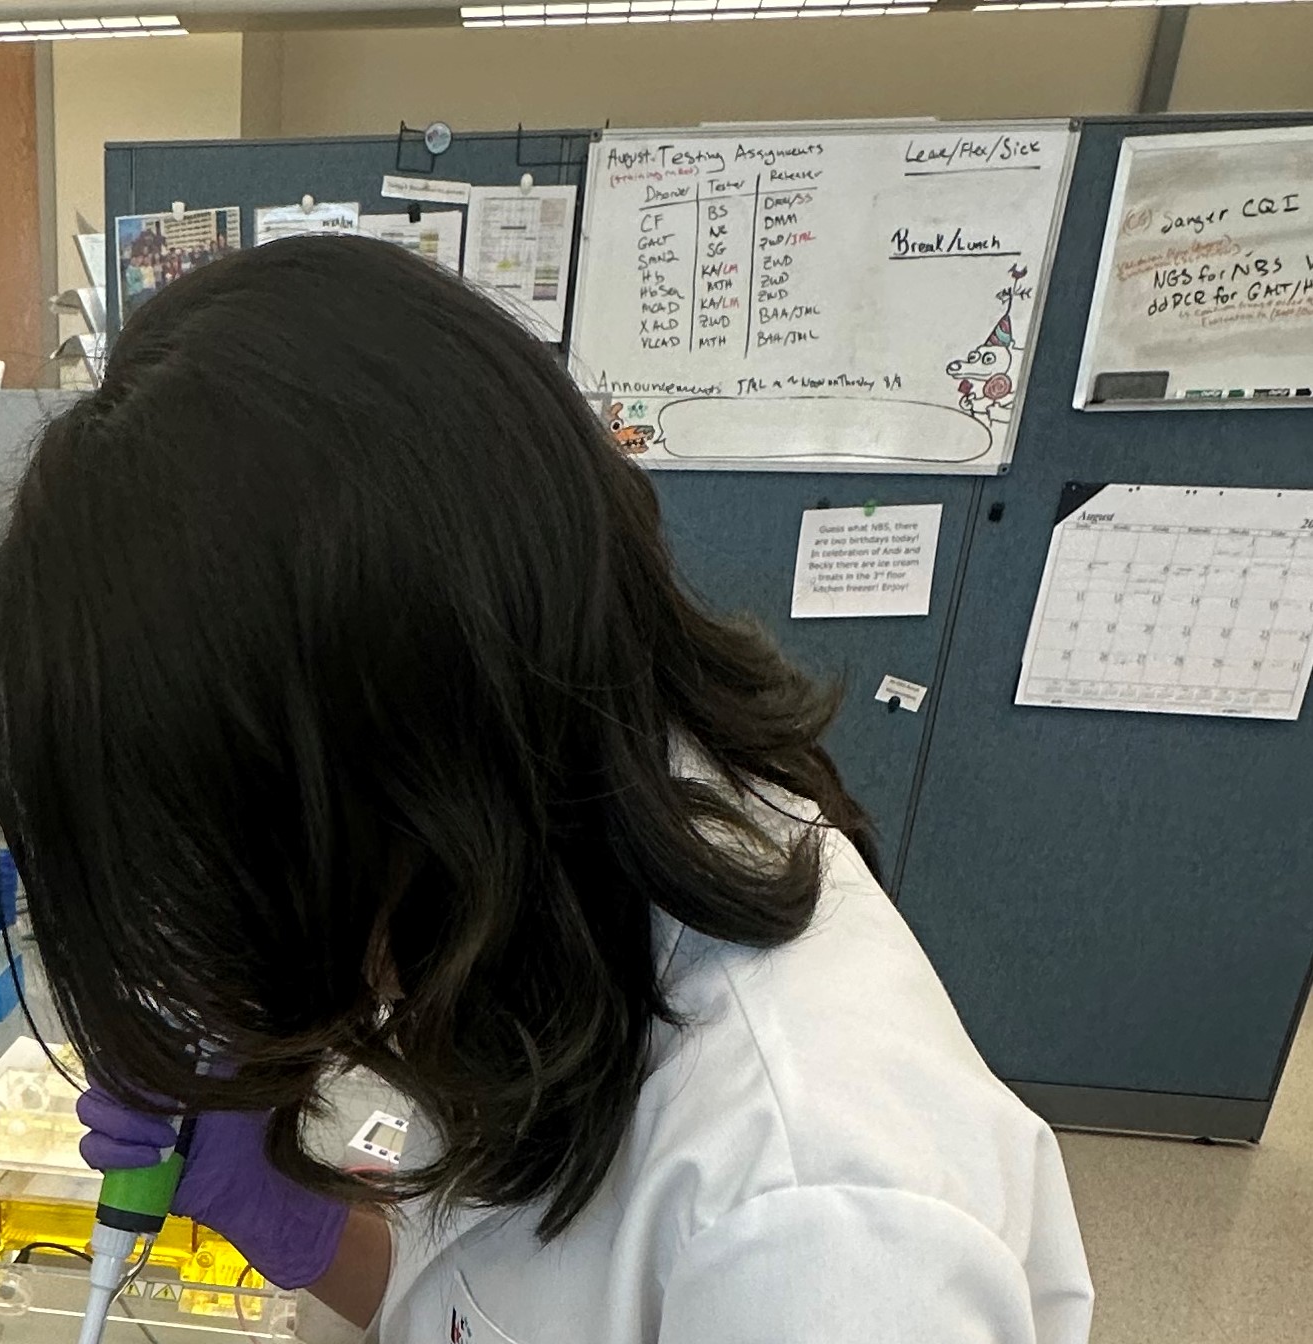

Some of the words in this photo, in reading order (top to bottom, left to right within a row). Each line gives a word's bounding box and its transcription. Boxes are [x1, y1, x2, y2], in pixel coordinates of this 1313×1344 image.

[658, 145, 726, 174] Testing
[640, 213, 664, 233] CF
[707, 205, 728, 221] BS
[706, 242, 727, 258] SG
[1153, 268, 1194, 290] NGS
[1197, 264, 1226, 282] for
[1212, 285, 1237, 305] for
[1077, 510, 1115, 525] August
